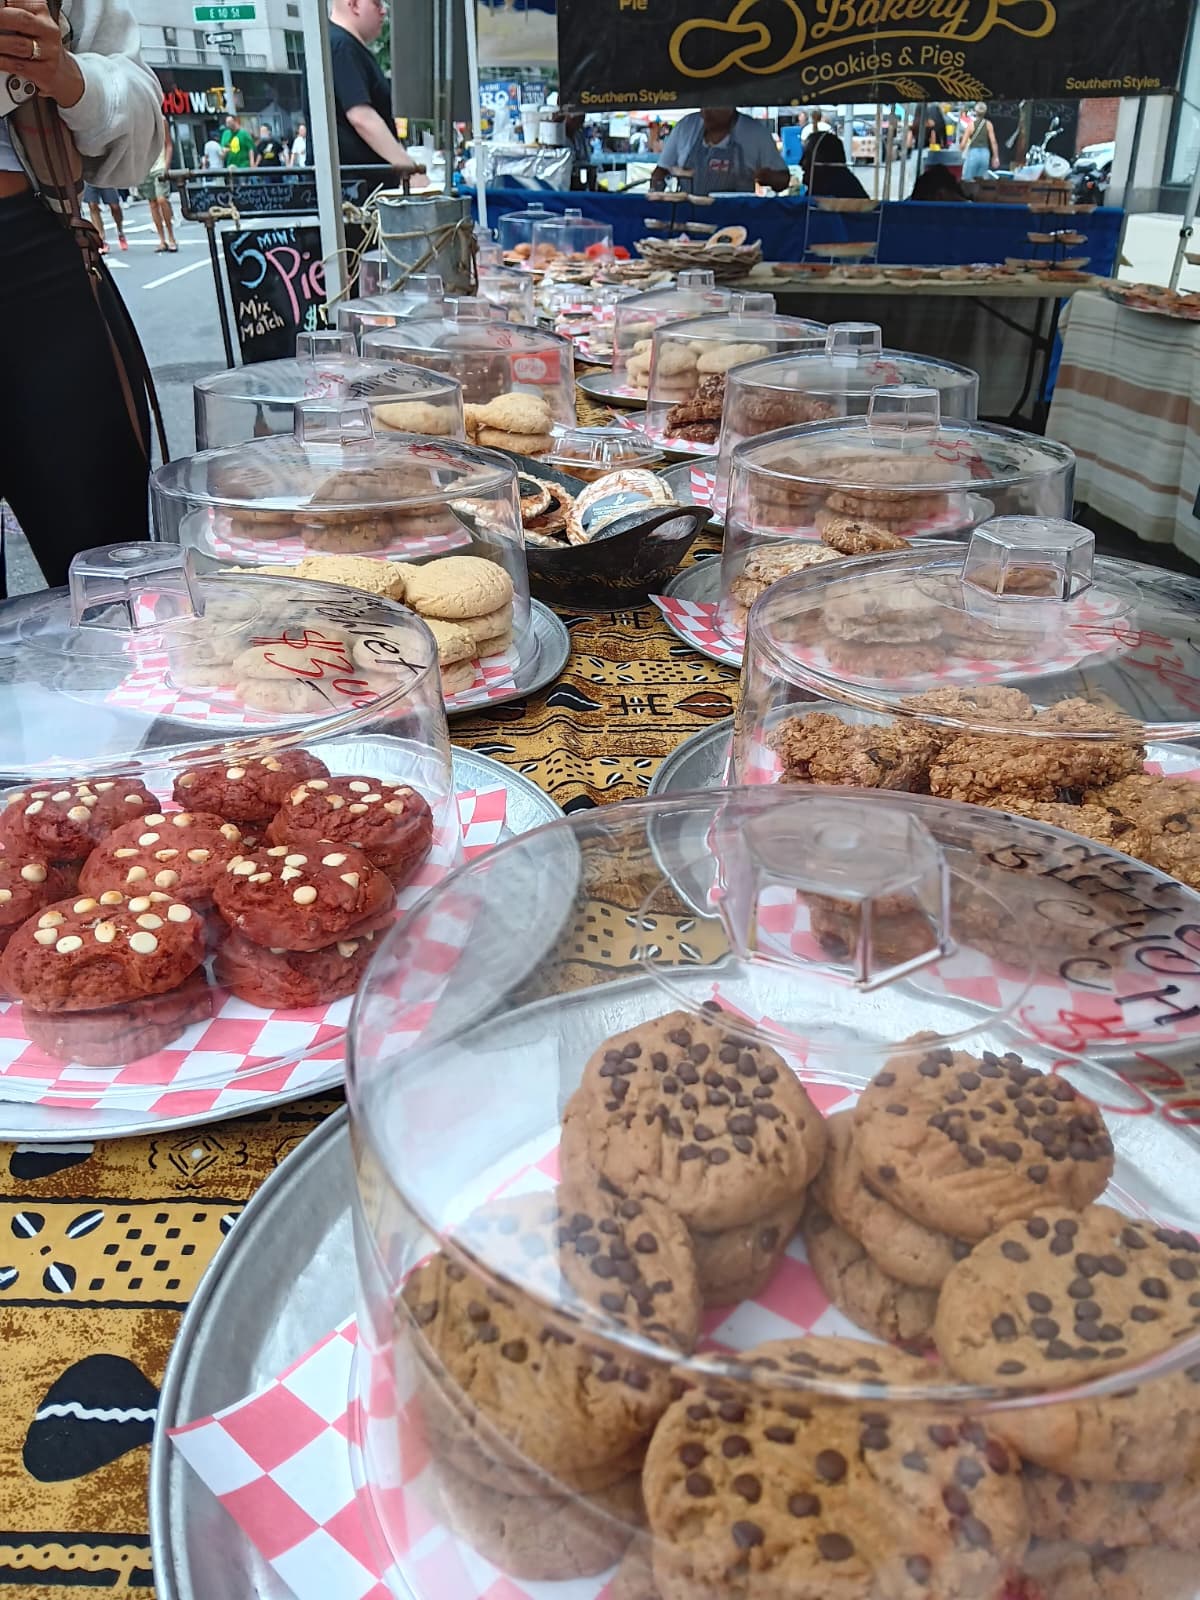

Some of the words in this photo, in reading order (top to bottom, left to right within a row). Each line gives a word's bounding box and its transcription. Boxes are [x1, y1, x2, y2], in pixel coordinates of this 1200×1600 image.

[209, 8, 215, 19] E
[217, 7, 229, 19] 10
[810, 0, 969, 40] Bakery
[800, 51, 893, 86] Cookies
[898, 46, 915, 66] &
[920, 44, 967, 67] Pies
[580, 91, 638, 105] Southern
[639, 89, 678, 105] Styles
[1066, 77, 1121, 91] Southern
[1123, 75, 1161, 91] Styles
[230, 231, 267, 289] 5
[239, 294, 272, 321] Mix
[240, 309, 286, 342] Match
